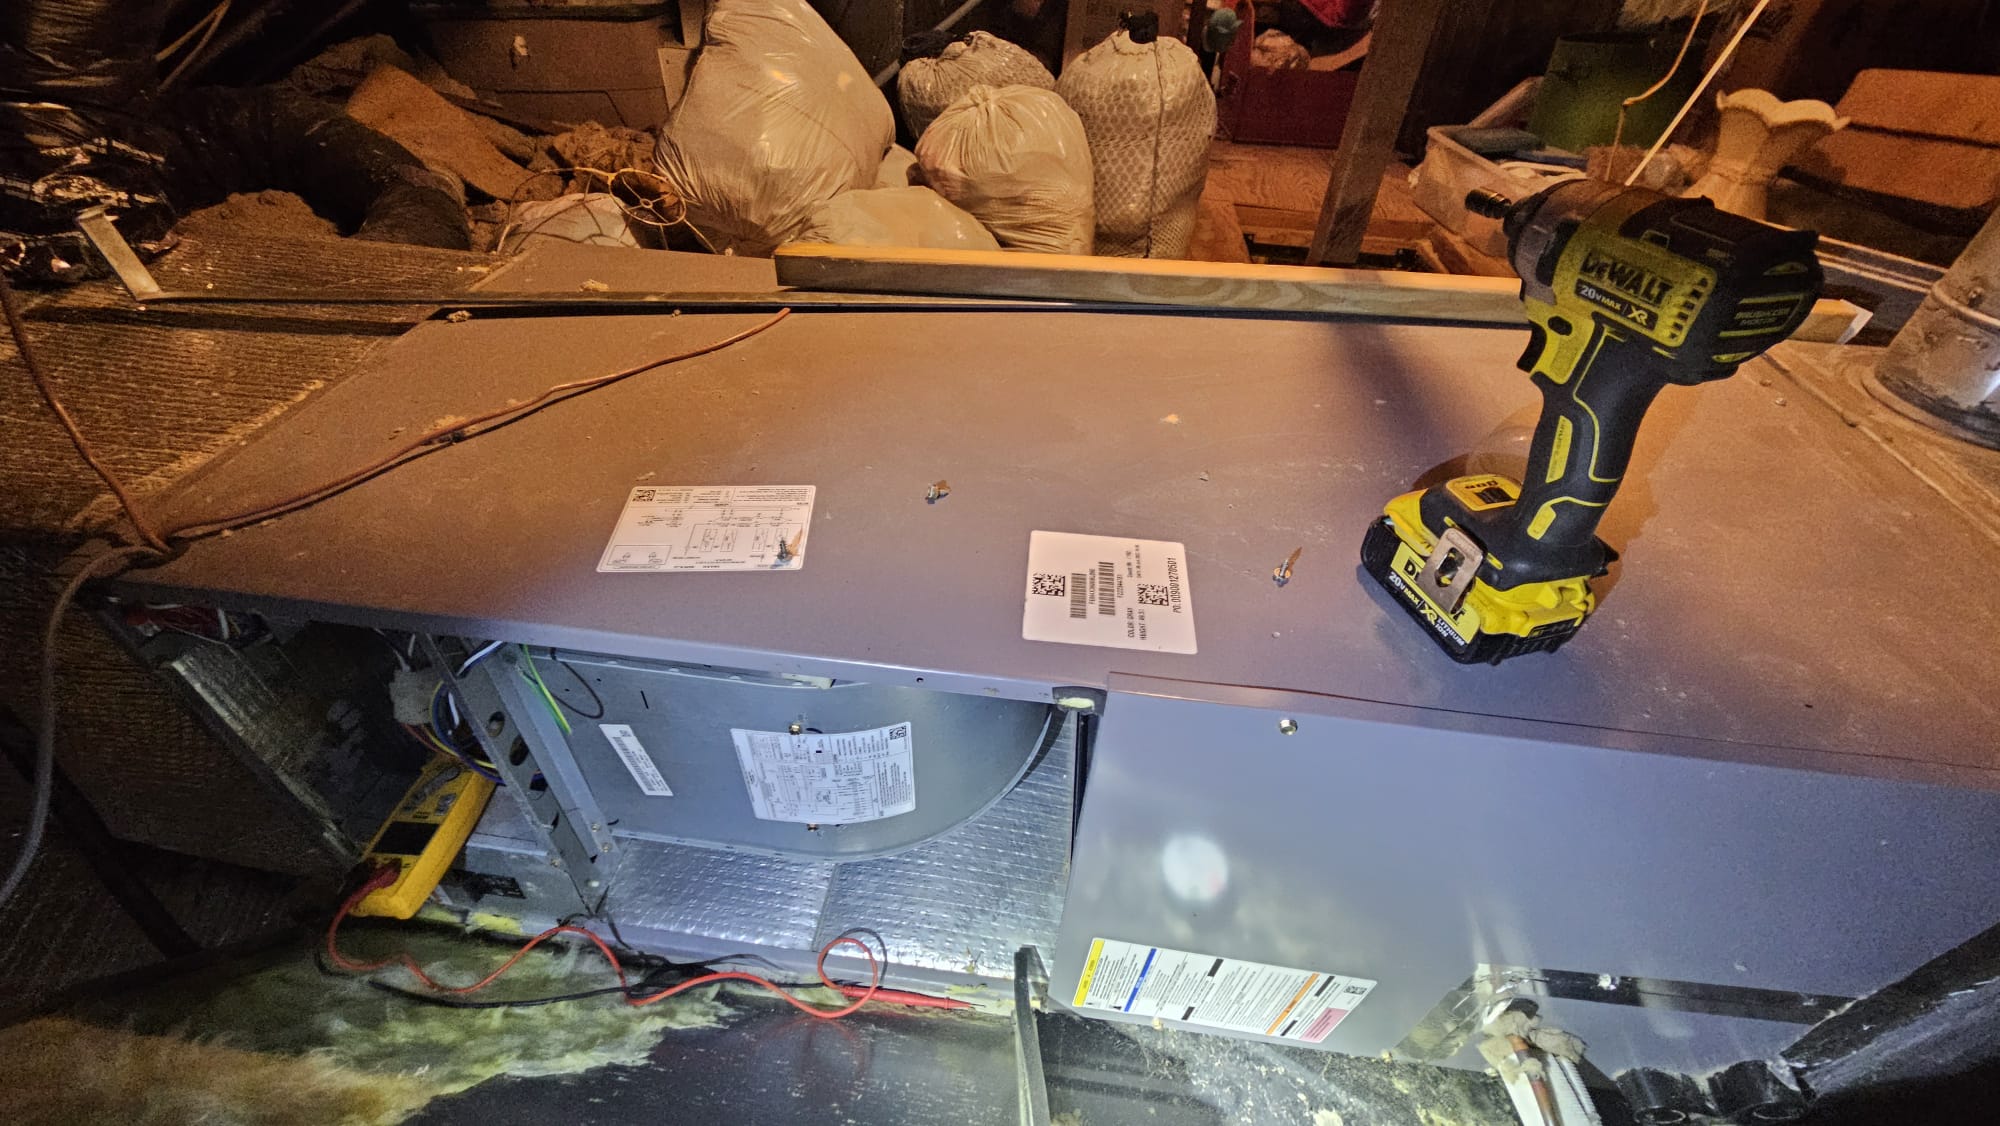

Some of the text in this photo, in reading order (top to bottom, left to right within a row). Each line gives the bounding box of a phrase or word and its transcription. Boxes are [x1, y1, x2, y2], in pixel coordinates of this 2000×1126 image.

[1580, 251, 1673, 306] DEWALT
[1627, 305, 1648, 326] XR
[1404, 588, 1420, 605] MAX
[1420, 604, 1438, 626] XR
[1434, 623, 1449, 638] ION
[1436, 617, 1465, 647] LITHIUM
